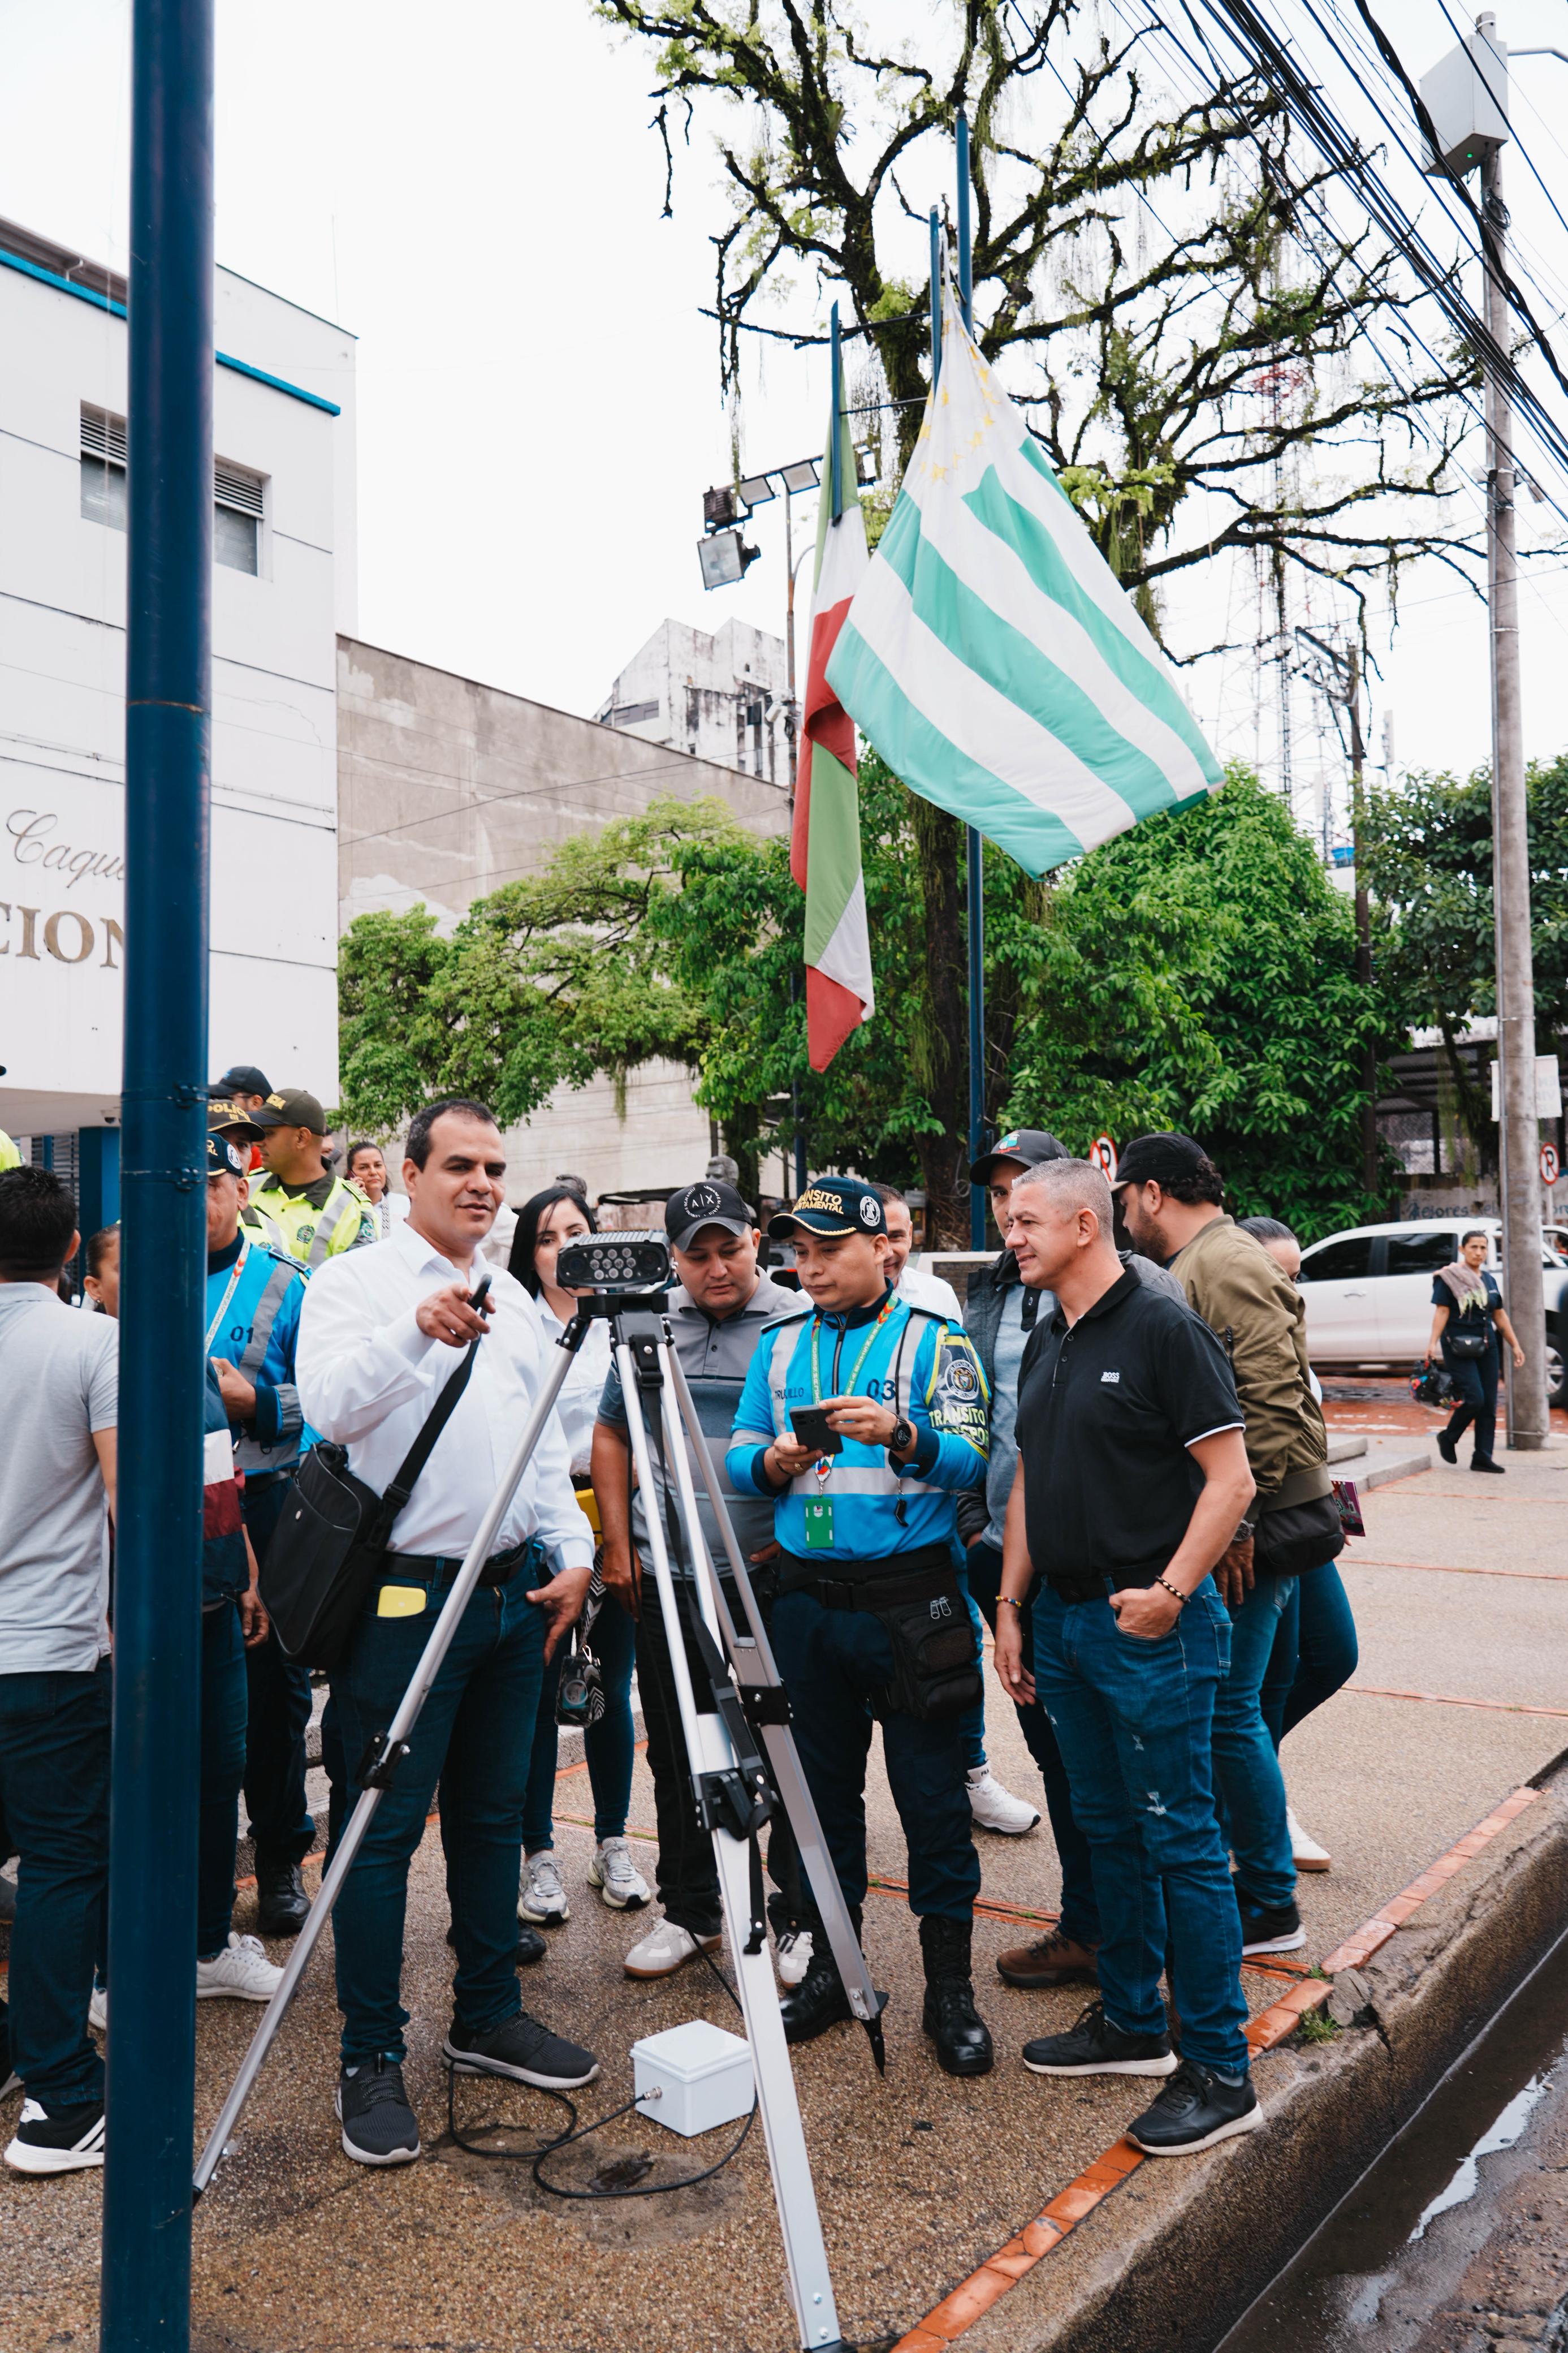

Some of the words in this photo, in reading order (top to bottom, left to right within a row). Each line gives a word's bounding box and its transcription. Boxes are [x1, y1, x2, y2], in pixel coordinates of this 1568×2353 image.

[0, 901, 125, 969] ION
[230, 1325, 254, 1344] 01
[866, 1378, 897, 1400] 03
